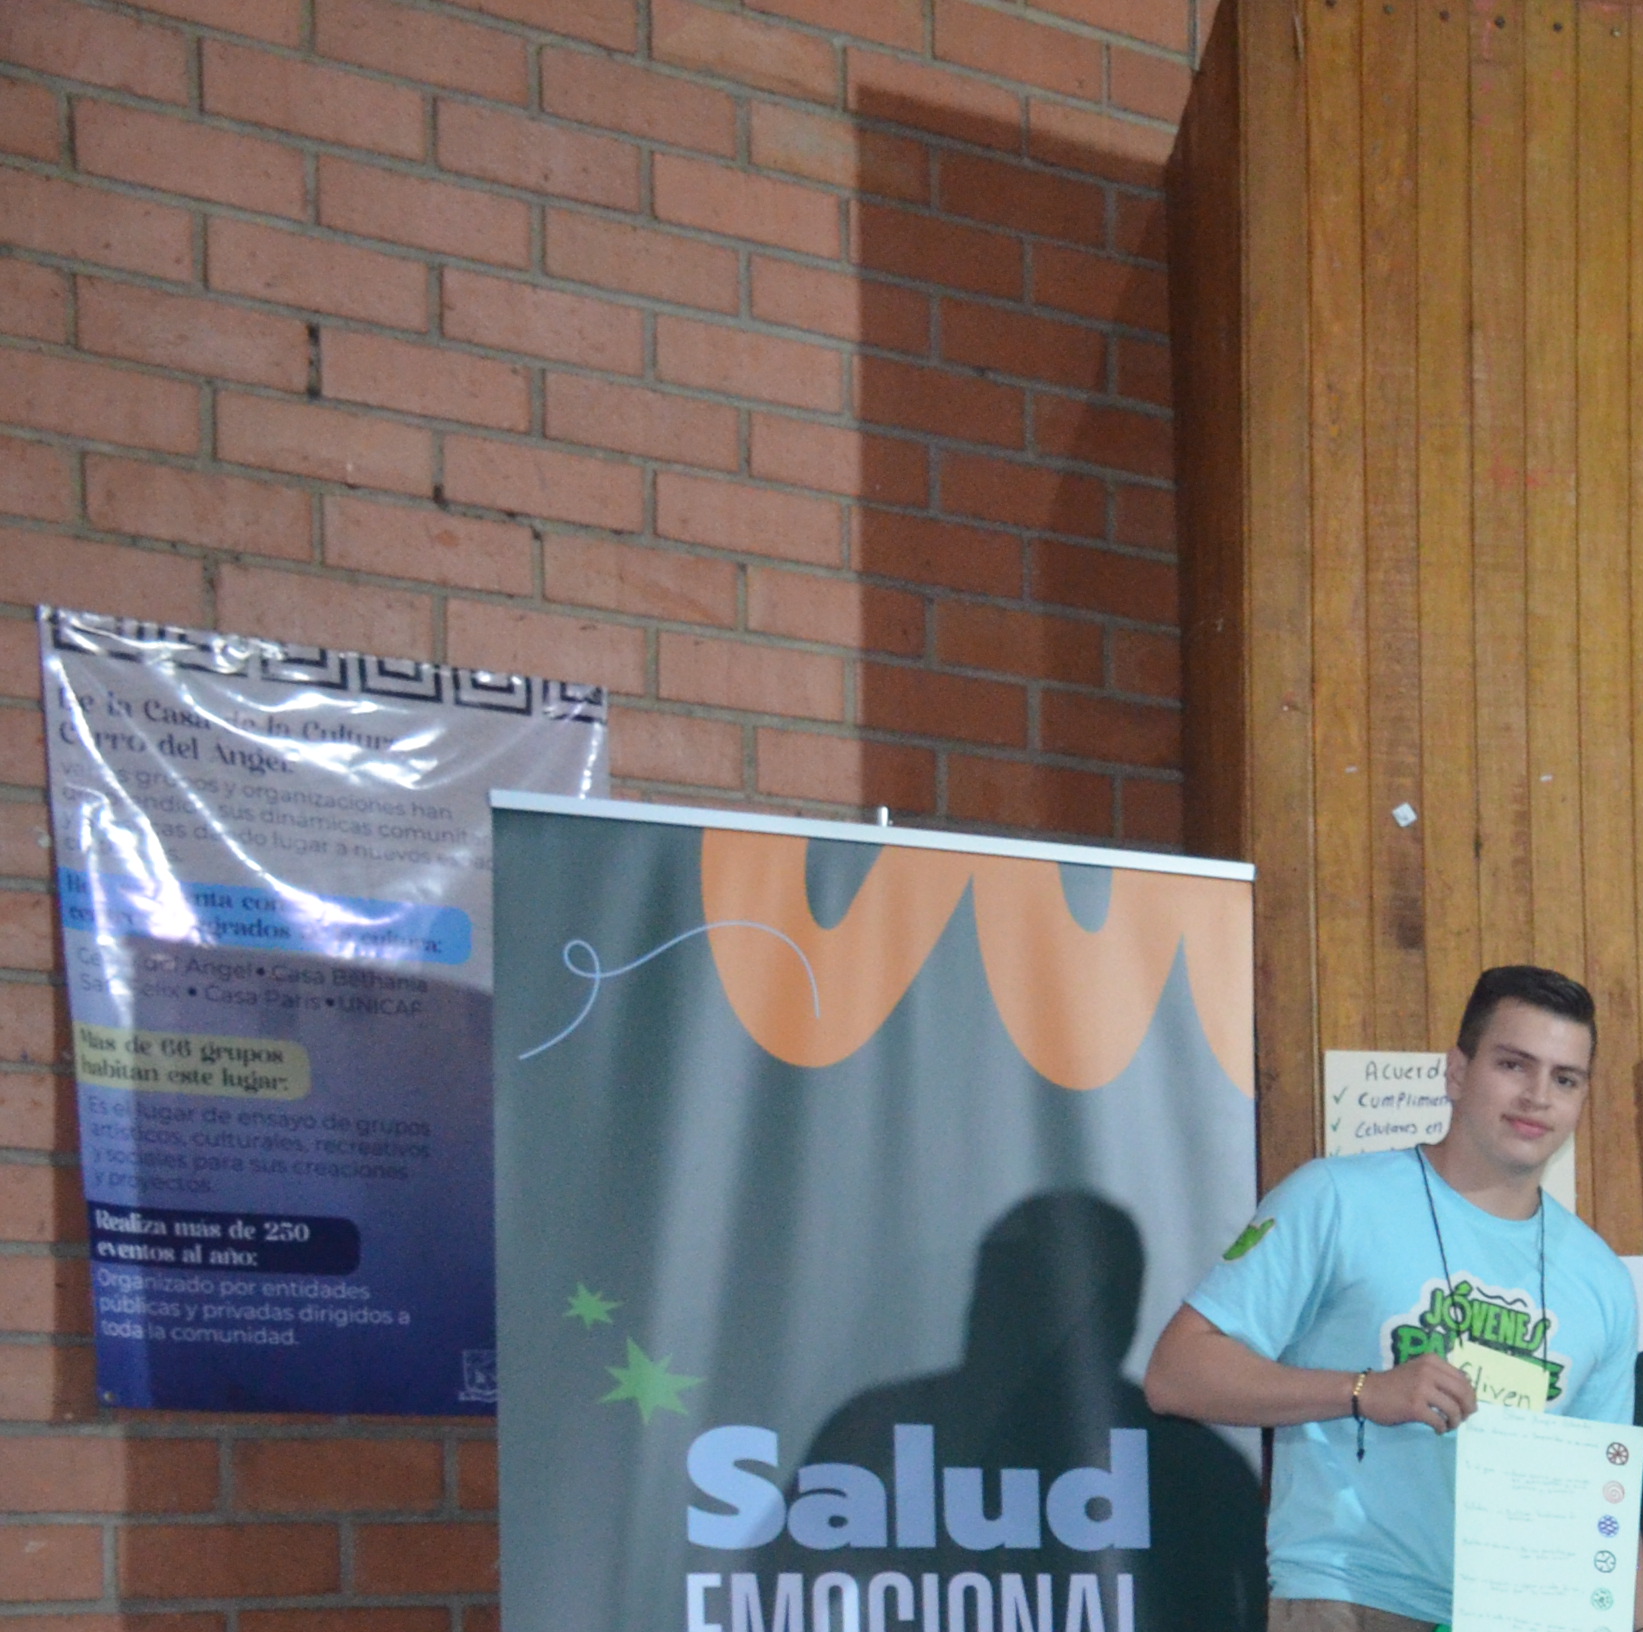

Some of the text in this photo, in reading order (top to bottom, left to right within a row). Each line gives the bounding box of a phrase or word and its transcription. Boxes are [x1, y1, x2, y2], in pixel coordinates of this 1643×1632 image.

[58, 720, 149, 752] Crro
[159, 733, 199, 760] del
[143, 698, 211, 731] Casa
[302, 720, 400, 751] Cultur
[81, 1053, 159, 1082] habitan
[166, 1069, 213, 1086] este
[200, 1043, 284, 1068] grupos
[1364, 1057, 1446, 1082] Acuerd
[94, 1208, 167, 1237] Realiza
[228, 1219, 258, 1241] de
[264, 1222, 312, 1243] 250
[96, 1238, 175, 1263] eventos
[180, 1243, 203, 1265] al
[97, 1266, 371, 1301] Organizado por entidades
[186, 1304, 200, 1321] y
[202, 1300, 295, 1323] privadas
[299, 1302, 394, 1328] dirigidos
[398, 1311, 412, 1326] a
[1419, 1280, 1552, 1352] JÓVENES
[101, 1319, 145, 1338] toda
[170, 1324, 301, 1346] comunidad.
[686, 1424, 1152, 1551] Salud
